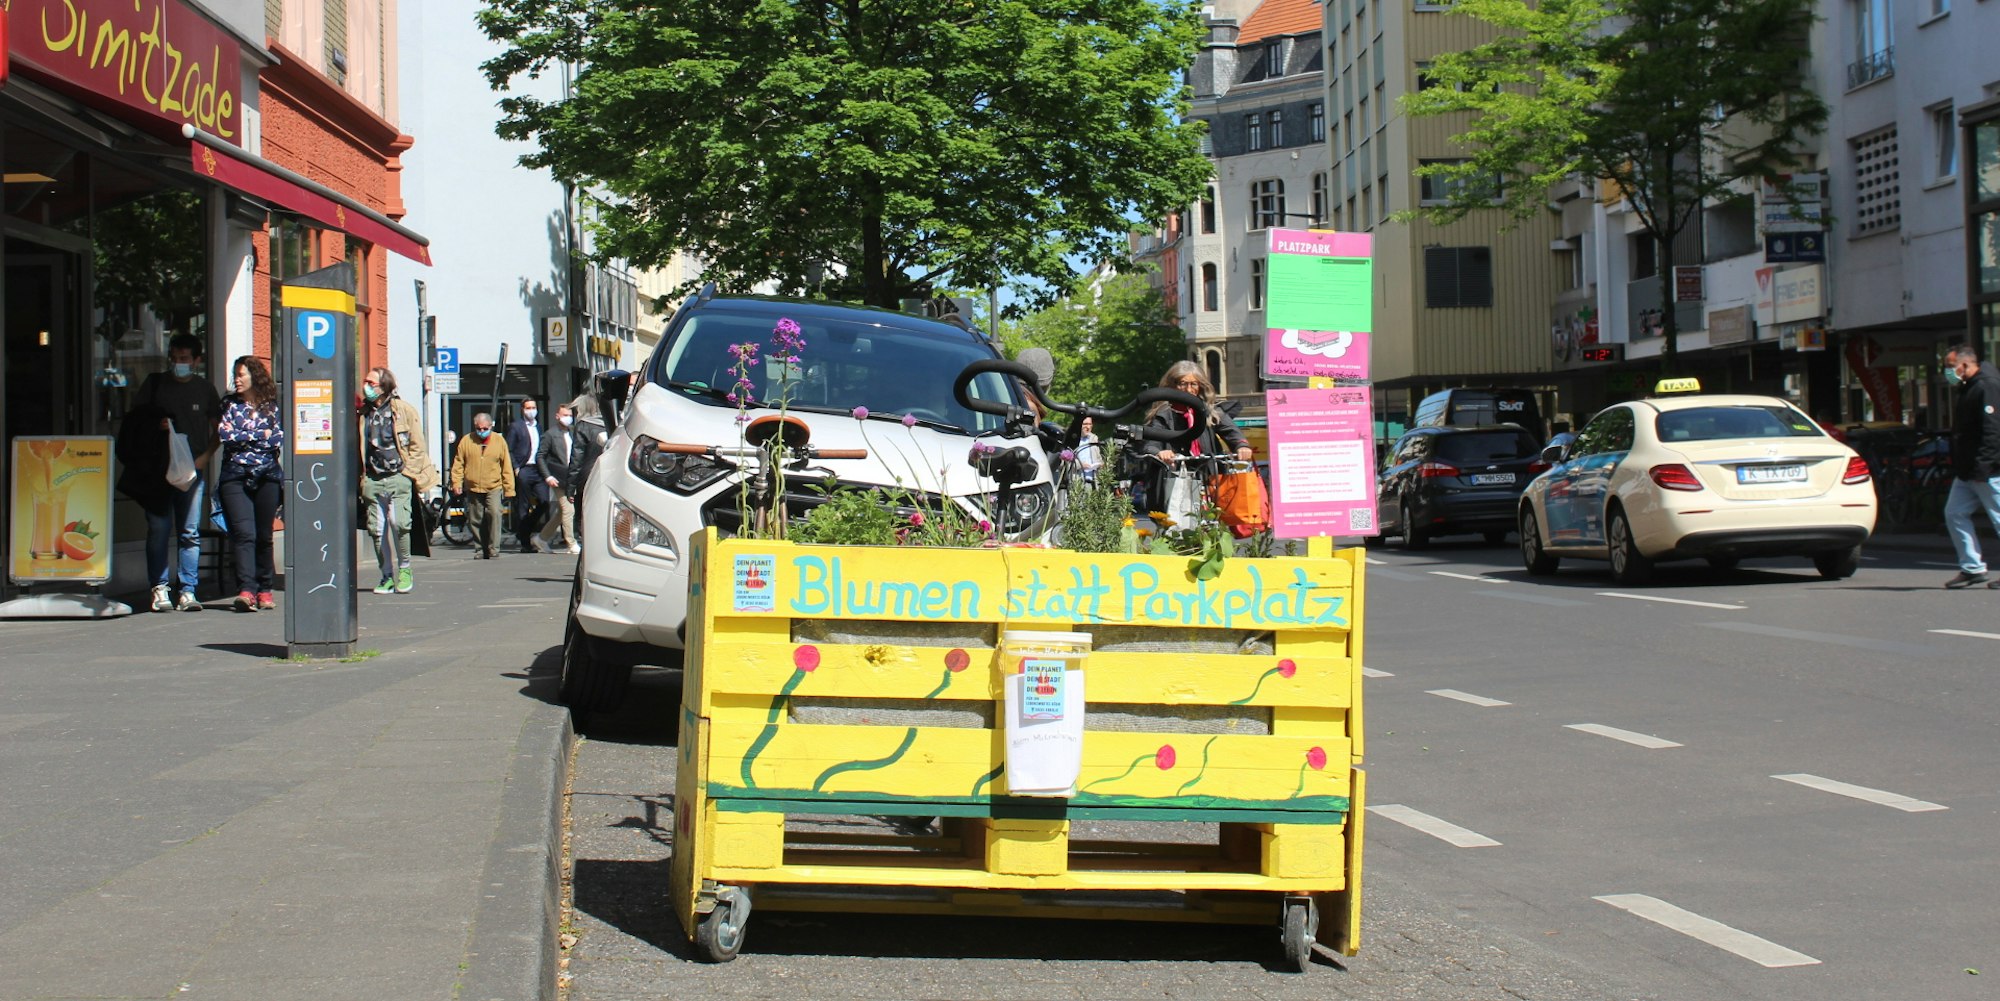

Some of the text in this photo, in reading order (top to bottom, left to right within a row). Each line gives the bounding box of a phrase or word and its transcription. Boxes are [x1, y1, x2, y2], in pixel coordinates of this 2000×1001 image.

[1277, 240, 1331, 254] PLATZPARK
[307, 316, 330, 350] P
[437, 351, 452, 370] P
[1663, 380, 1696, 390] TAXI
[1498, 400, 1525, 411] SIXT
[1748, 468, 1757, 479] K
[750, 559, 772, 567] PLANET
[789, 555, 1347, 629] Blumen statt Parkplatz
